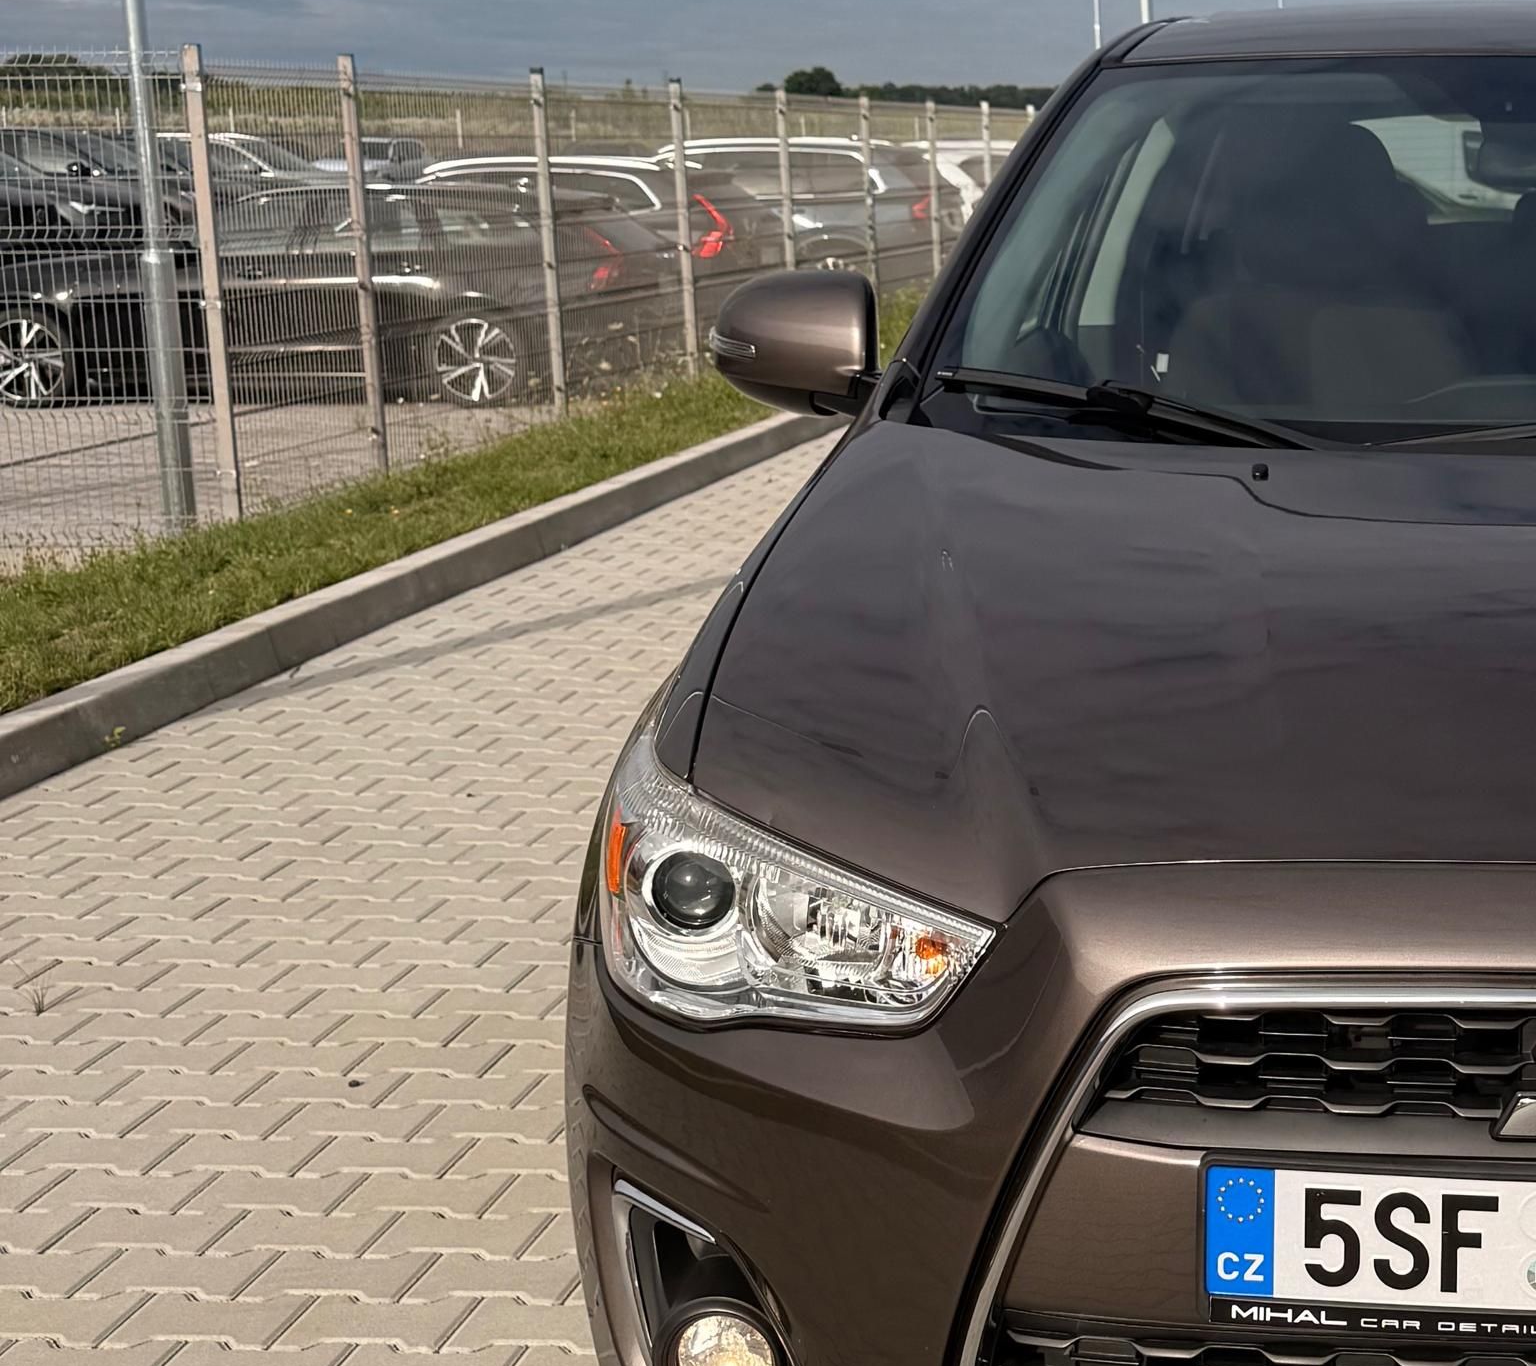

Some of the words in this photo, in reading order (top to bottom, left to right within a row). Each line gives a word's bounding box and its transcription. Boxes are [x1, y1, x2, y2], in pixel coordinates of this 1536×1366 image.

[1304, 1187, 1500, 1294] 5SF
[1216, 1251, 1265, 1282] CZ
[1231, 1304, 1348, 1326] MIHAL
[1360, 1318, 1421, 1331] CAR
